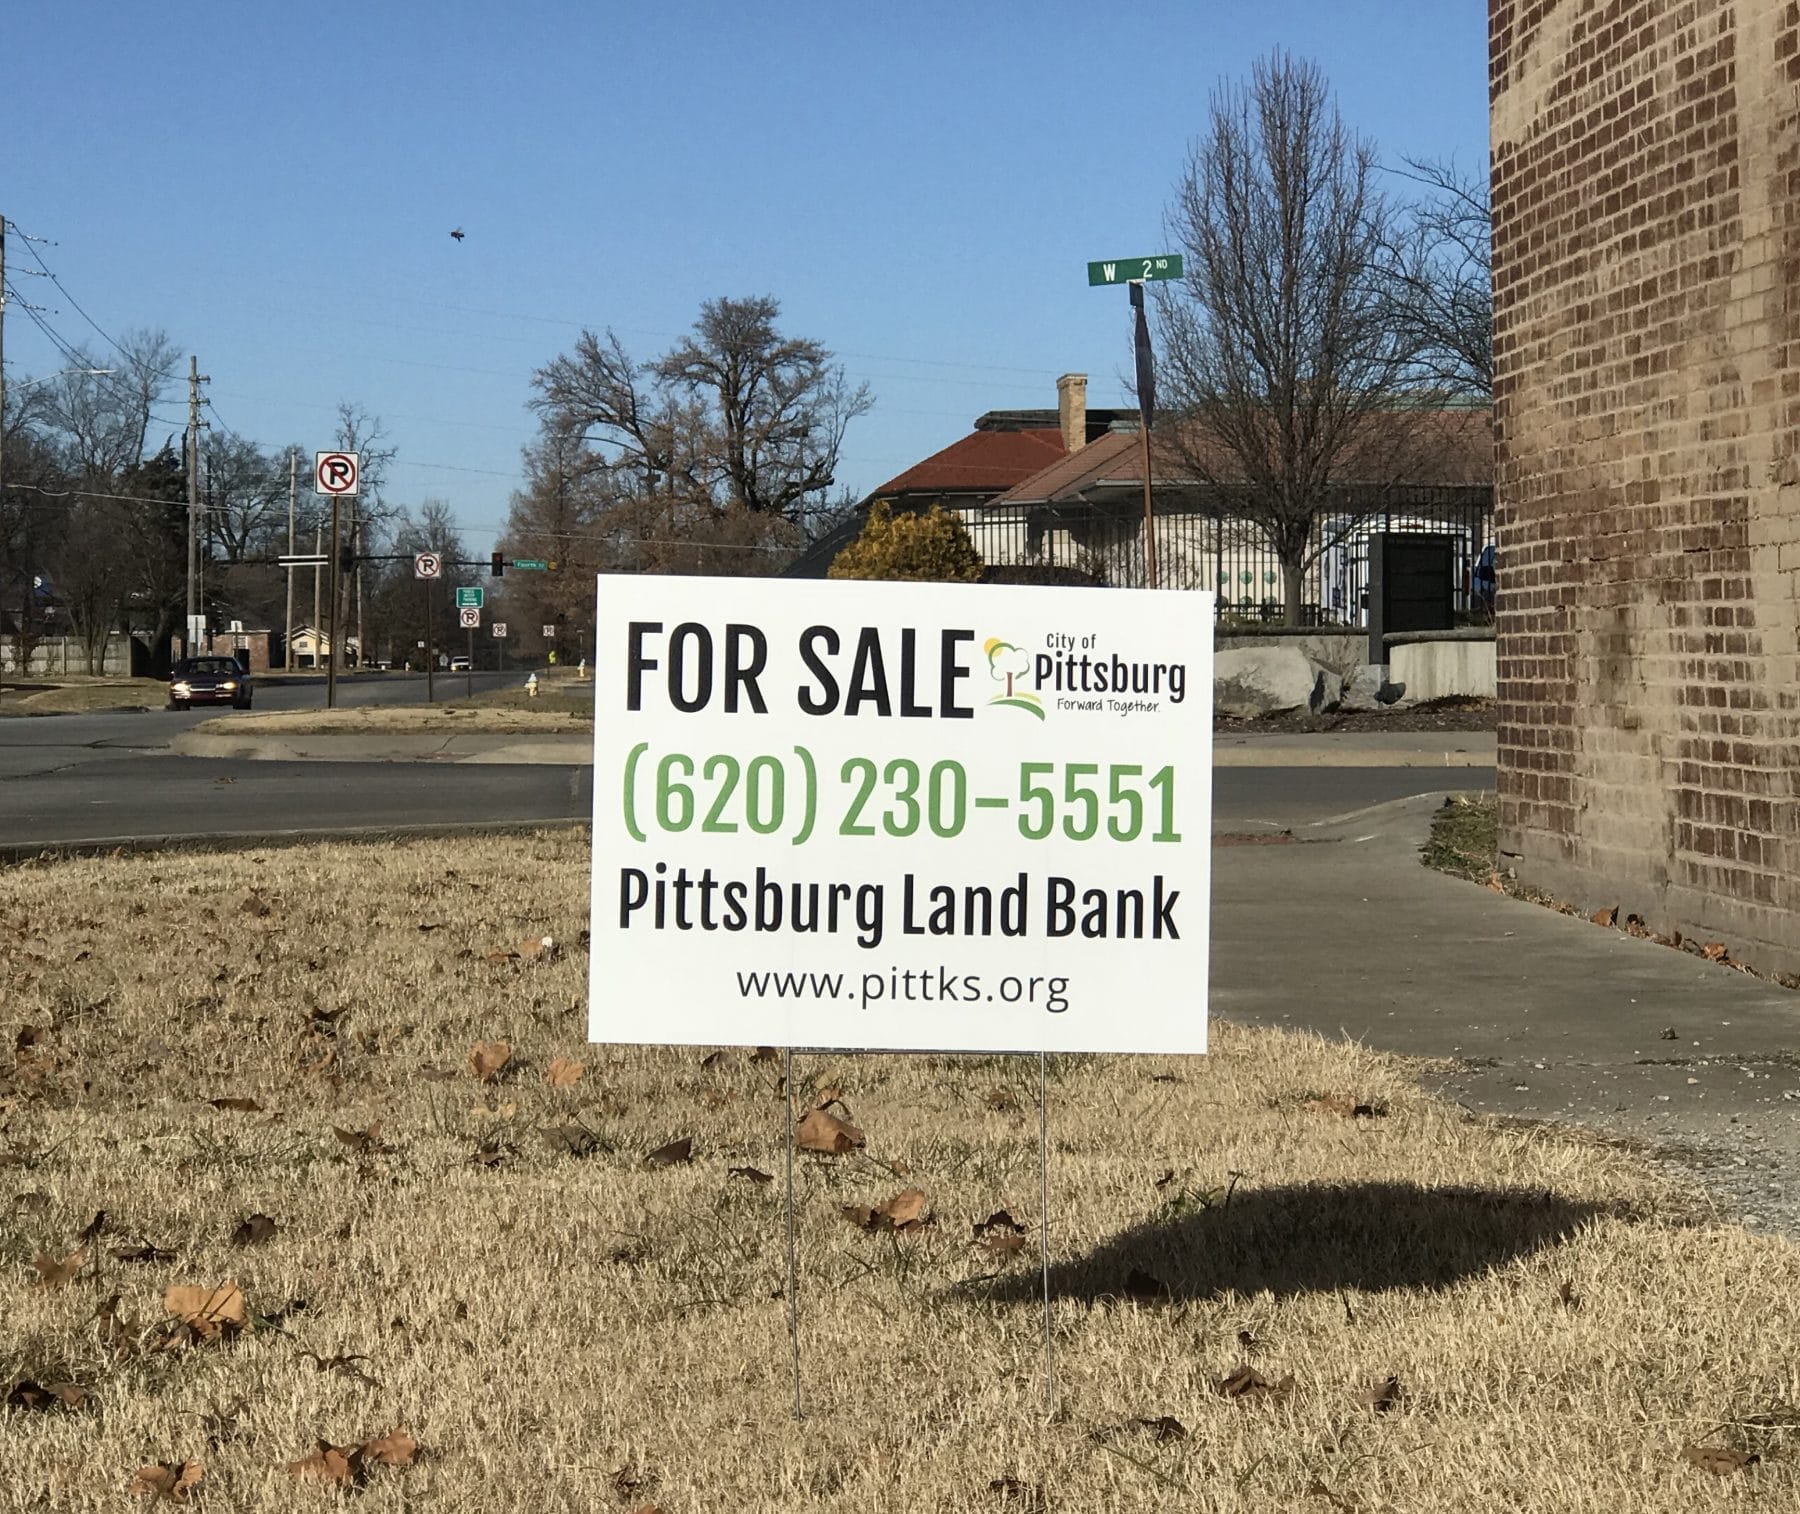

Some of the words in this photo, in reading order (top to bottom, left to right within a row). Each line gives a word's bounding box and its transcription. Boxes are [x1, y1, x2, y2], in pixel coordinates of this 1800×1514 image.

[1103, 263, 1115, 281] W
[1046, 632, 1076, 654] City
[1081, 633, 1097, 650] of
[627, 622, 768, 714] FOR
[798, 625, 975, 719] SALE
[1035, 651, 1186, 704] Pittsburg
[1057, 698, 1103, 711] Forward
[624, 743, 817, 845] (620)
[839, 758, 1181, 842] 230-5551
[619, 862, 884, 949] Pittsburg
[903, 873, 1028, 937] Land
[1047, 875, 1181, 940] Bank
[737, 966, 1069, 1013] www.pittks.org
